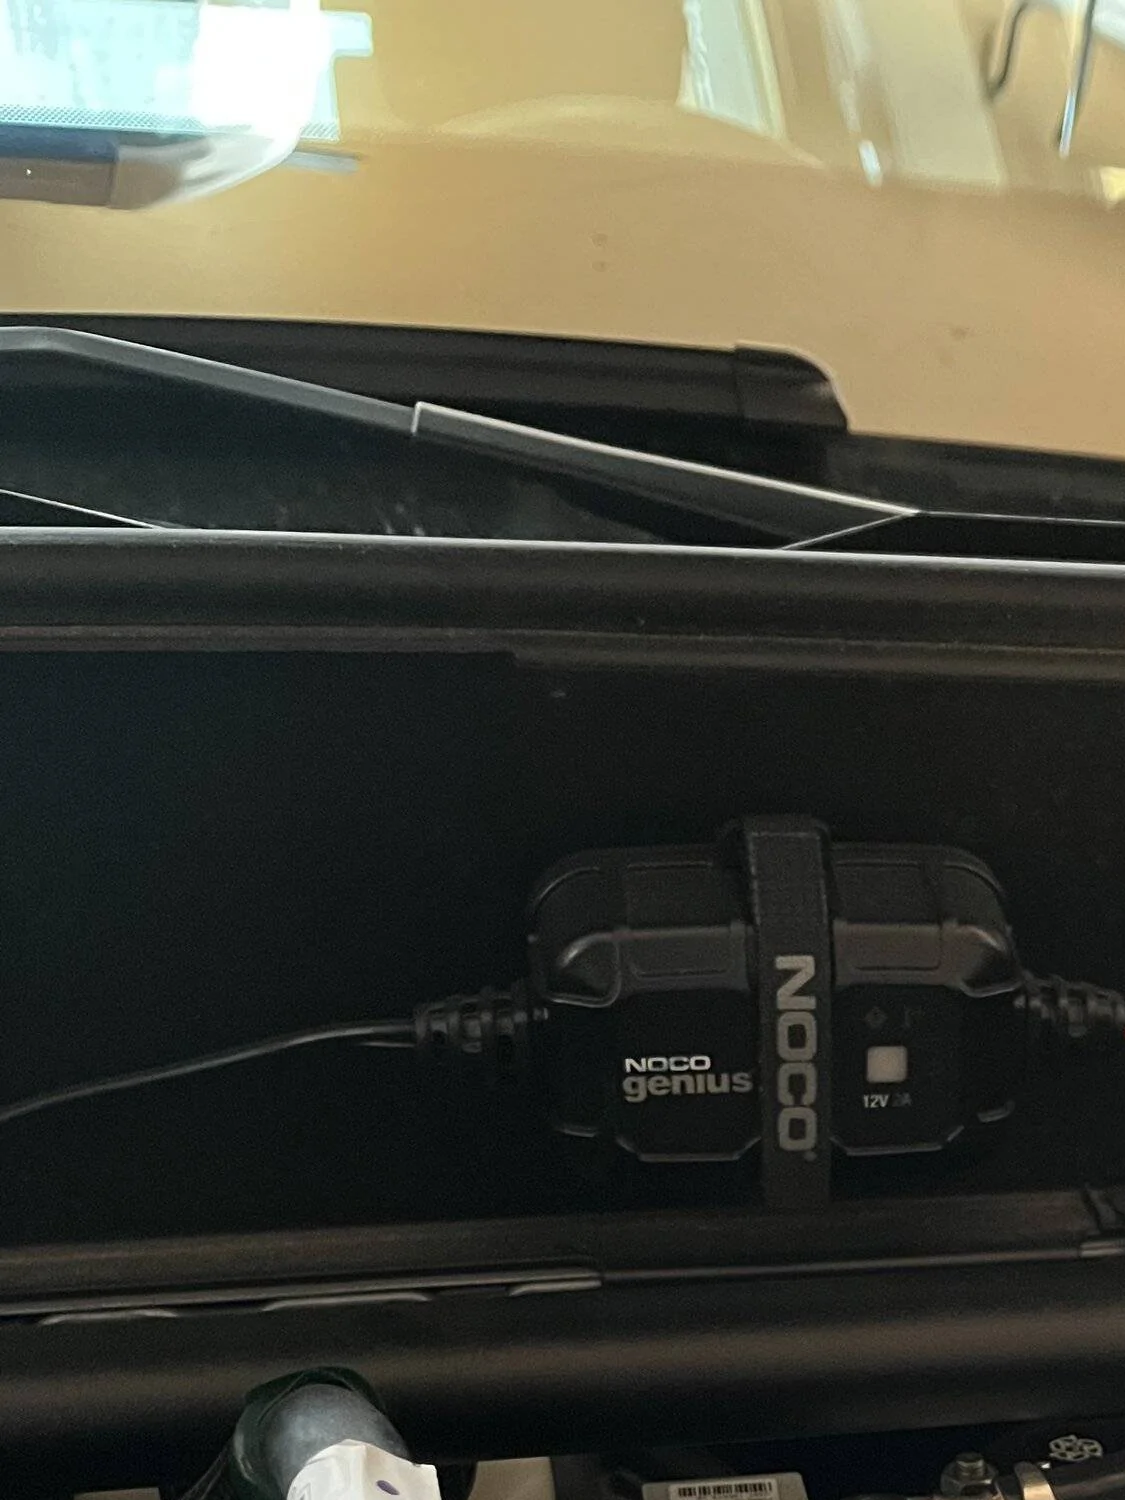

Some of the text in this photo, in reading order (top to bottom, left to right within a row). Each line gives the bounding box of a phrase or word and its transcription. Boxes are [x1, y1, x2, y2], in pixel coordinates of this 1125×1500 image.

[624, 1055, 711, 1073] NOCO
[775, 955, 817, 1151] NOCO
[622, 1071, 753, 1103] genius
[863, 1094, 889, 1108] 12V
